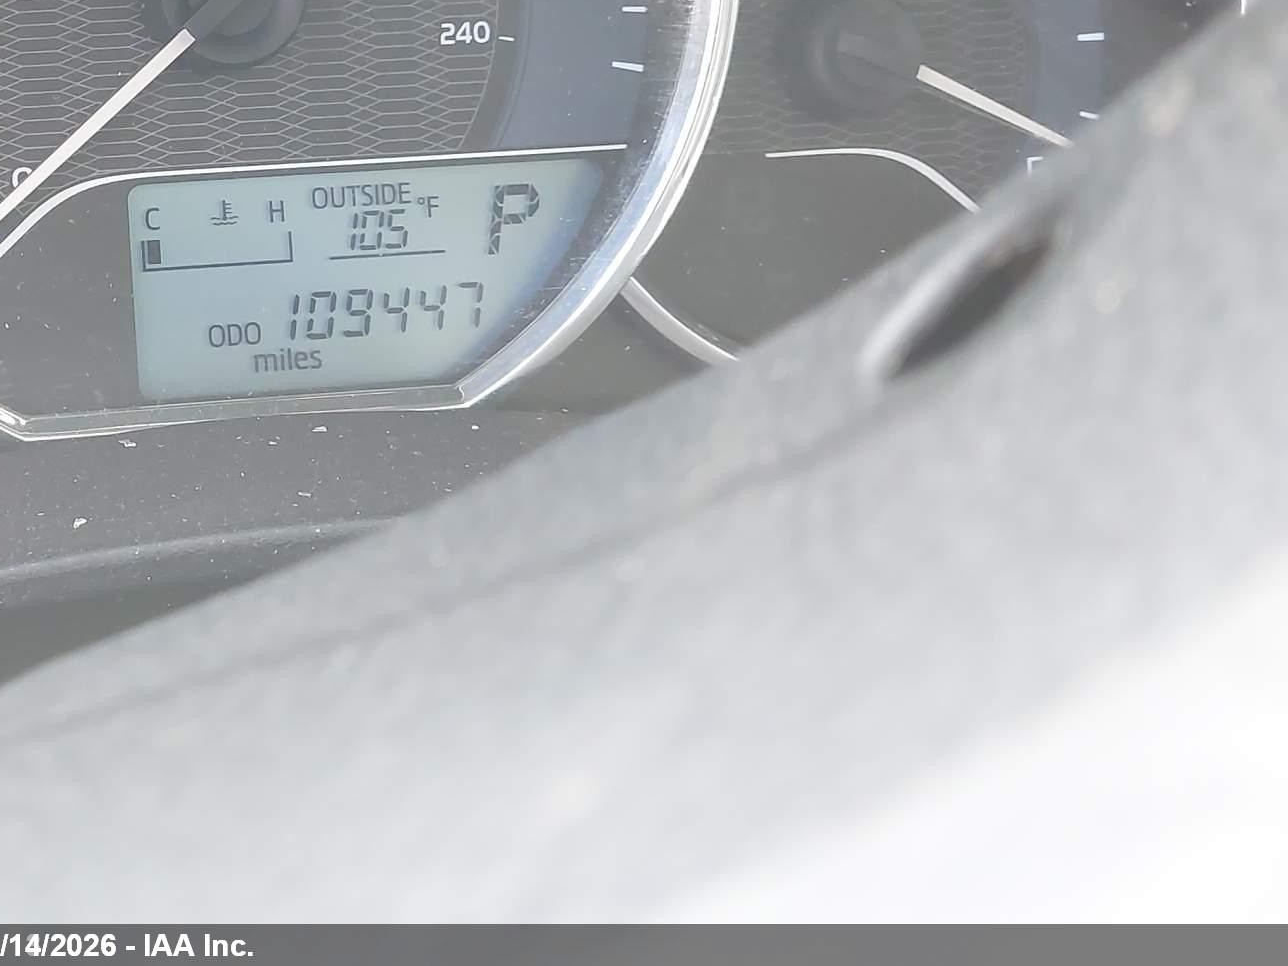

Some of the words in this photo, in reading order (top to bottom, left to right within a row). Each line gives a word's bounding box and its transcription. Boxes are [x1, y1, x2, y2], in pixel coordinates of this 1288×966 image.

[440, 21, 490, 45] 240
[311, 182, 411, 210] OUTSIDE
[145, 207, 160, 230] C
[269, 200, 285, 223] H
[349, 209, 408, 251] 105
[417, 195, 440, 218] °F
[488, 183, 540, 256] P
[208, 322, 261, 348] ODO
[289, 281, 483, 341] 109447
[253, 347, 323, 374] miles
